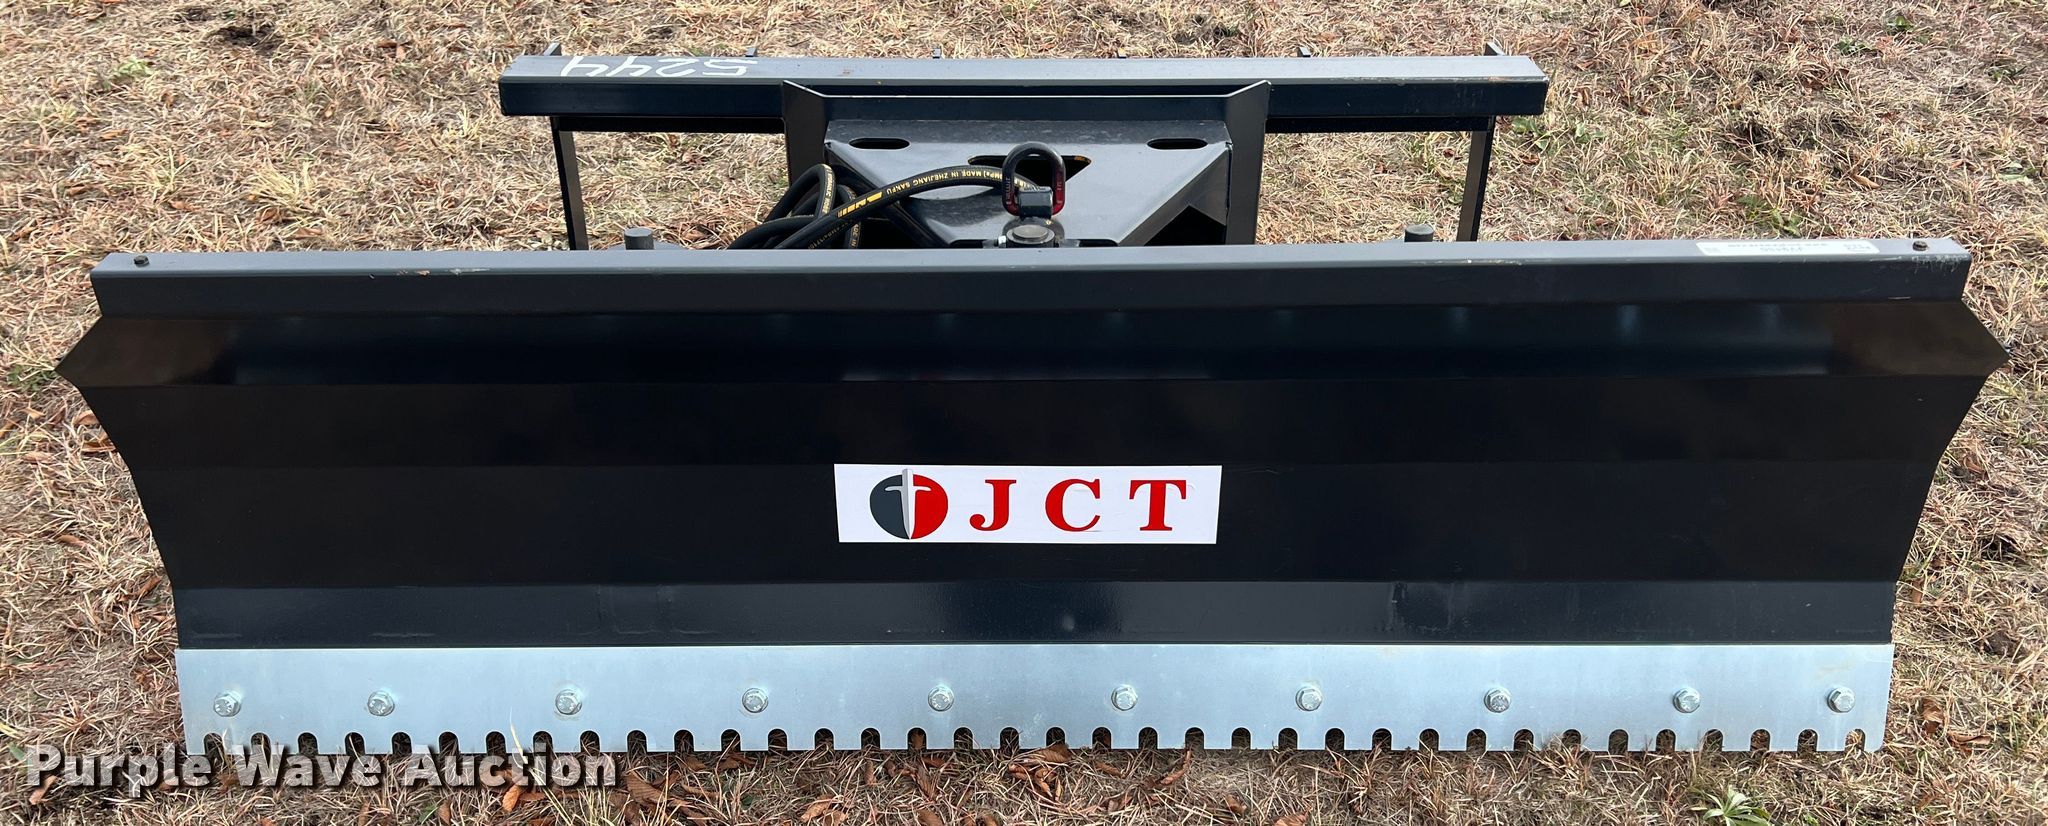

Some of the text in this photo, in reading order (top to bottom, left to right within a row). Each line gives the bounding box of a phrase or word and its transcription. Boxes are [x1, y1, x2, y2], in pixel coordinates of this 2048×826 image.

[560, 56, 758, 77] 5244
[913, 172, 949, 187] ZHEJIANG
[962, 169, 982, 177] MADE
[969, 478, 1187, 532] JCT
